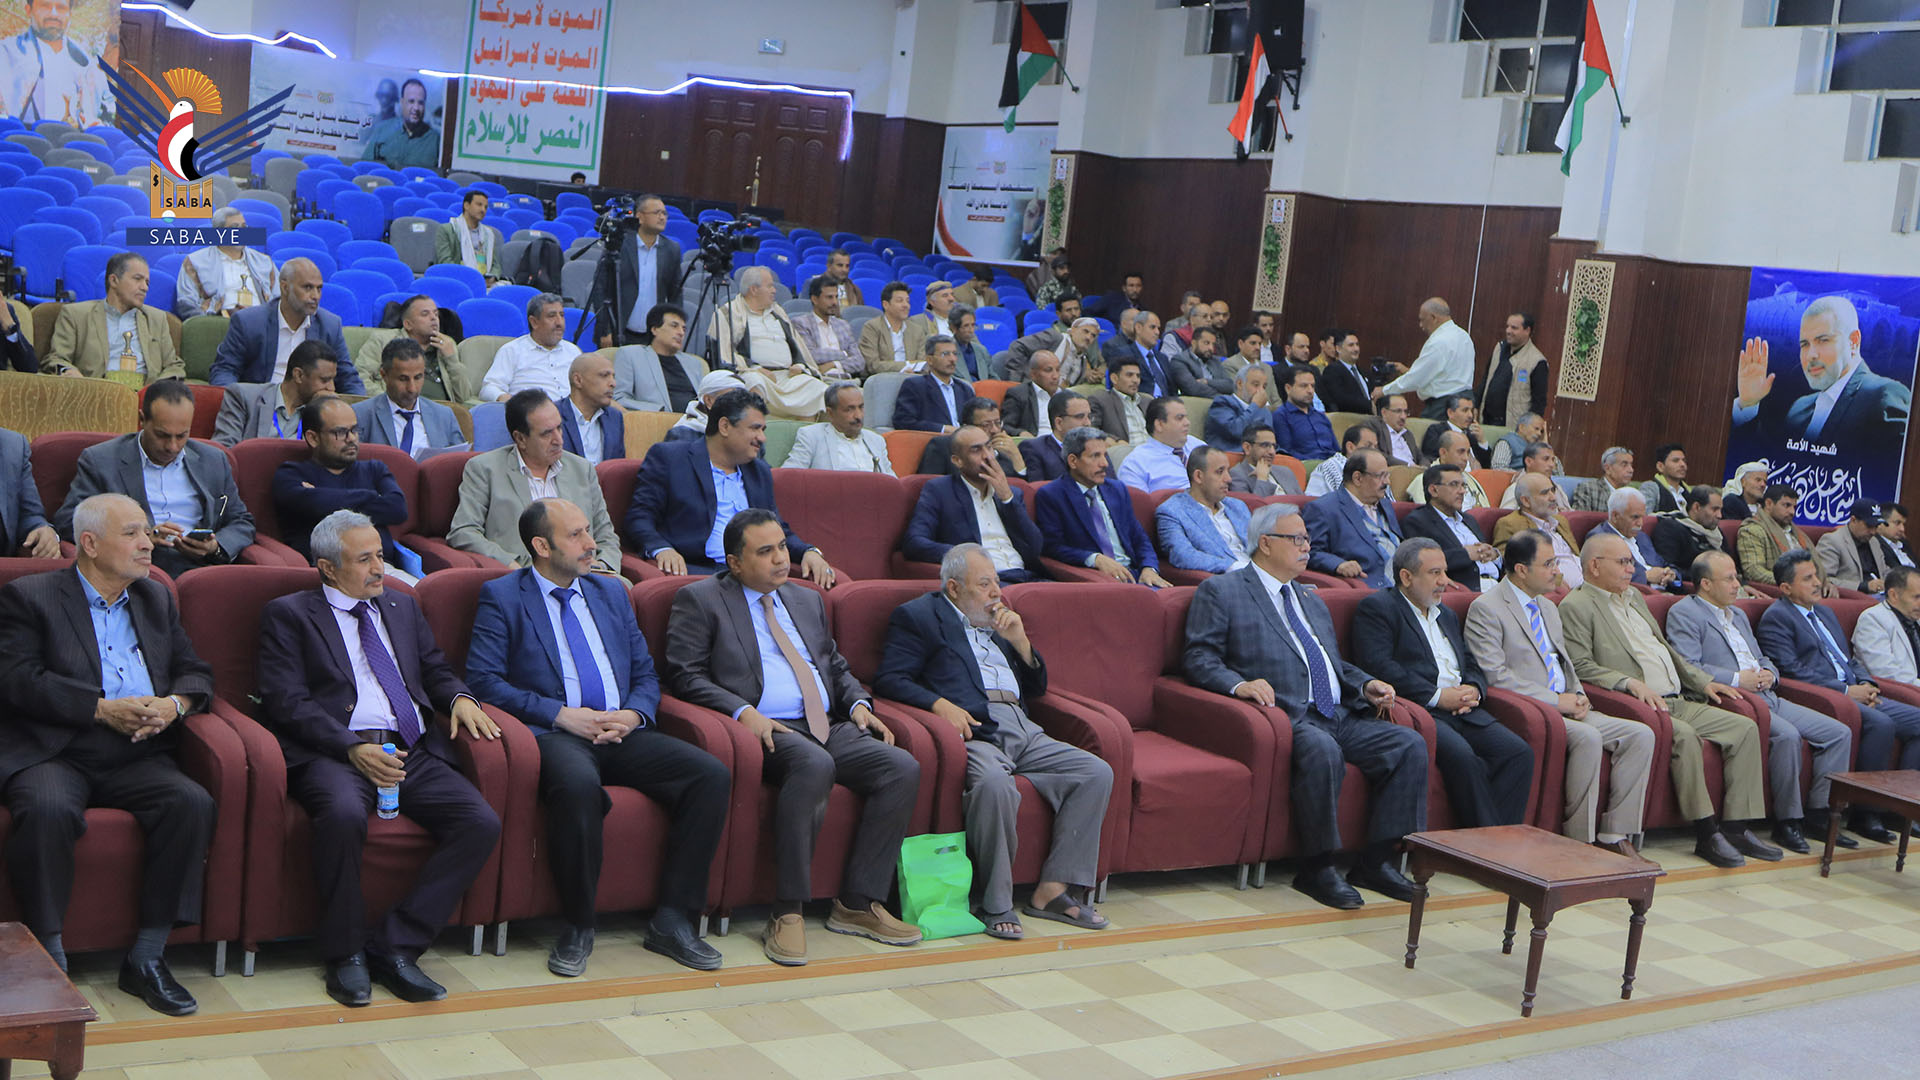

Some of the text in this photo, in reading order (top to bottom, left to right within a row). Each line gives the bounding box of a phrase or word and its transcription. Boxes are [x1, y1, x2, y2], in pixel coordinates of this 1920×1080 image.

[548, 7, 602, 33] الموت
[474, 37, 598, 72] الموت لإسرائيل
[470, 78, 516, 103] اليهود
[520, 79, 545, 107] على
[466, 110, 591, 155] النصر للإسلام
[1786, 437, 1838, 456] شهيد الأمة
